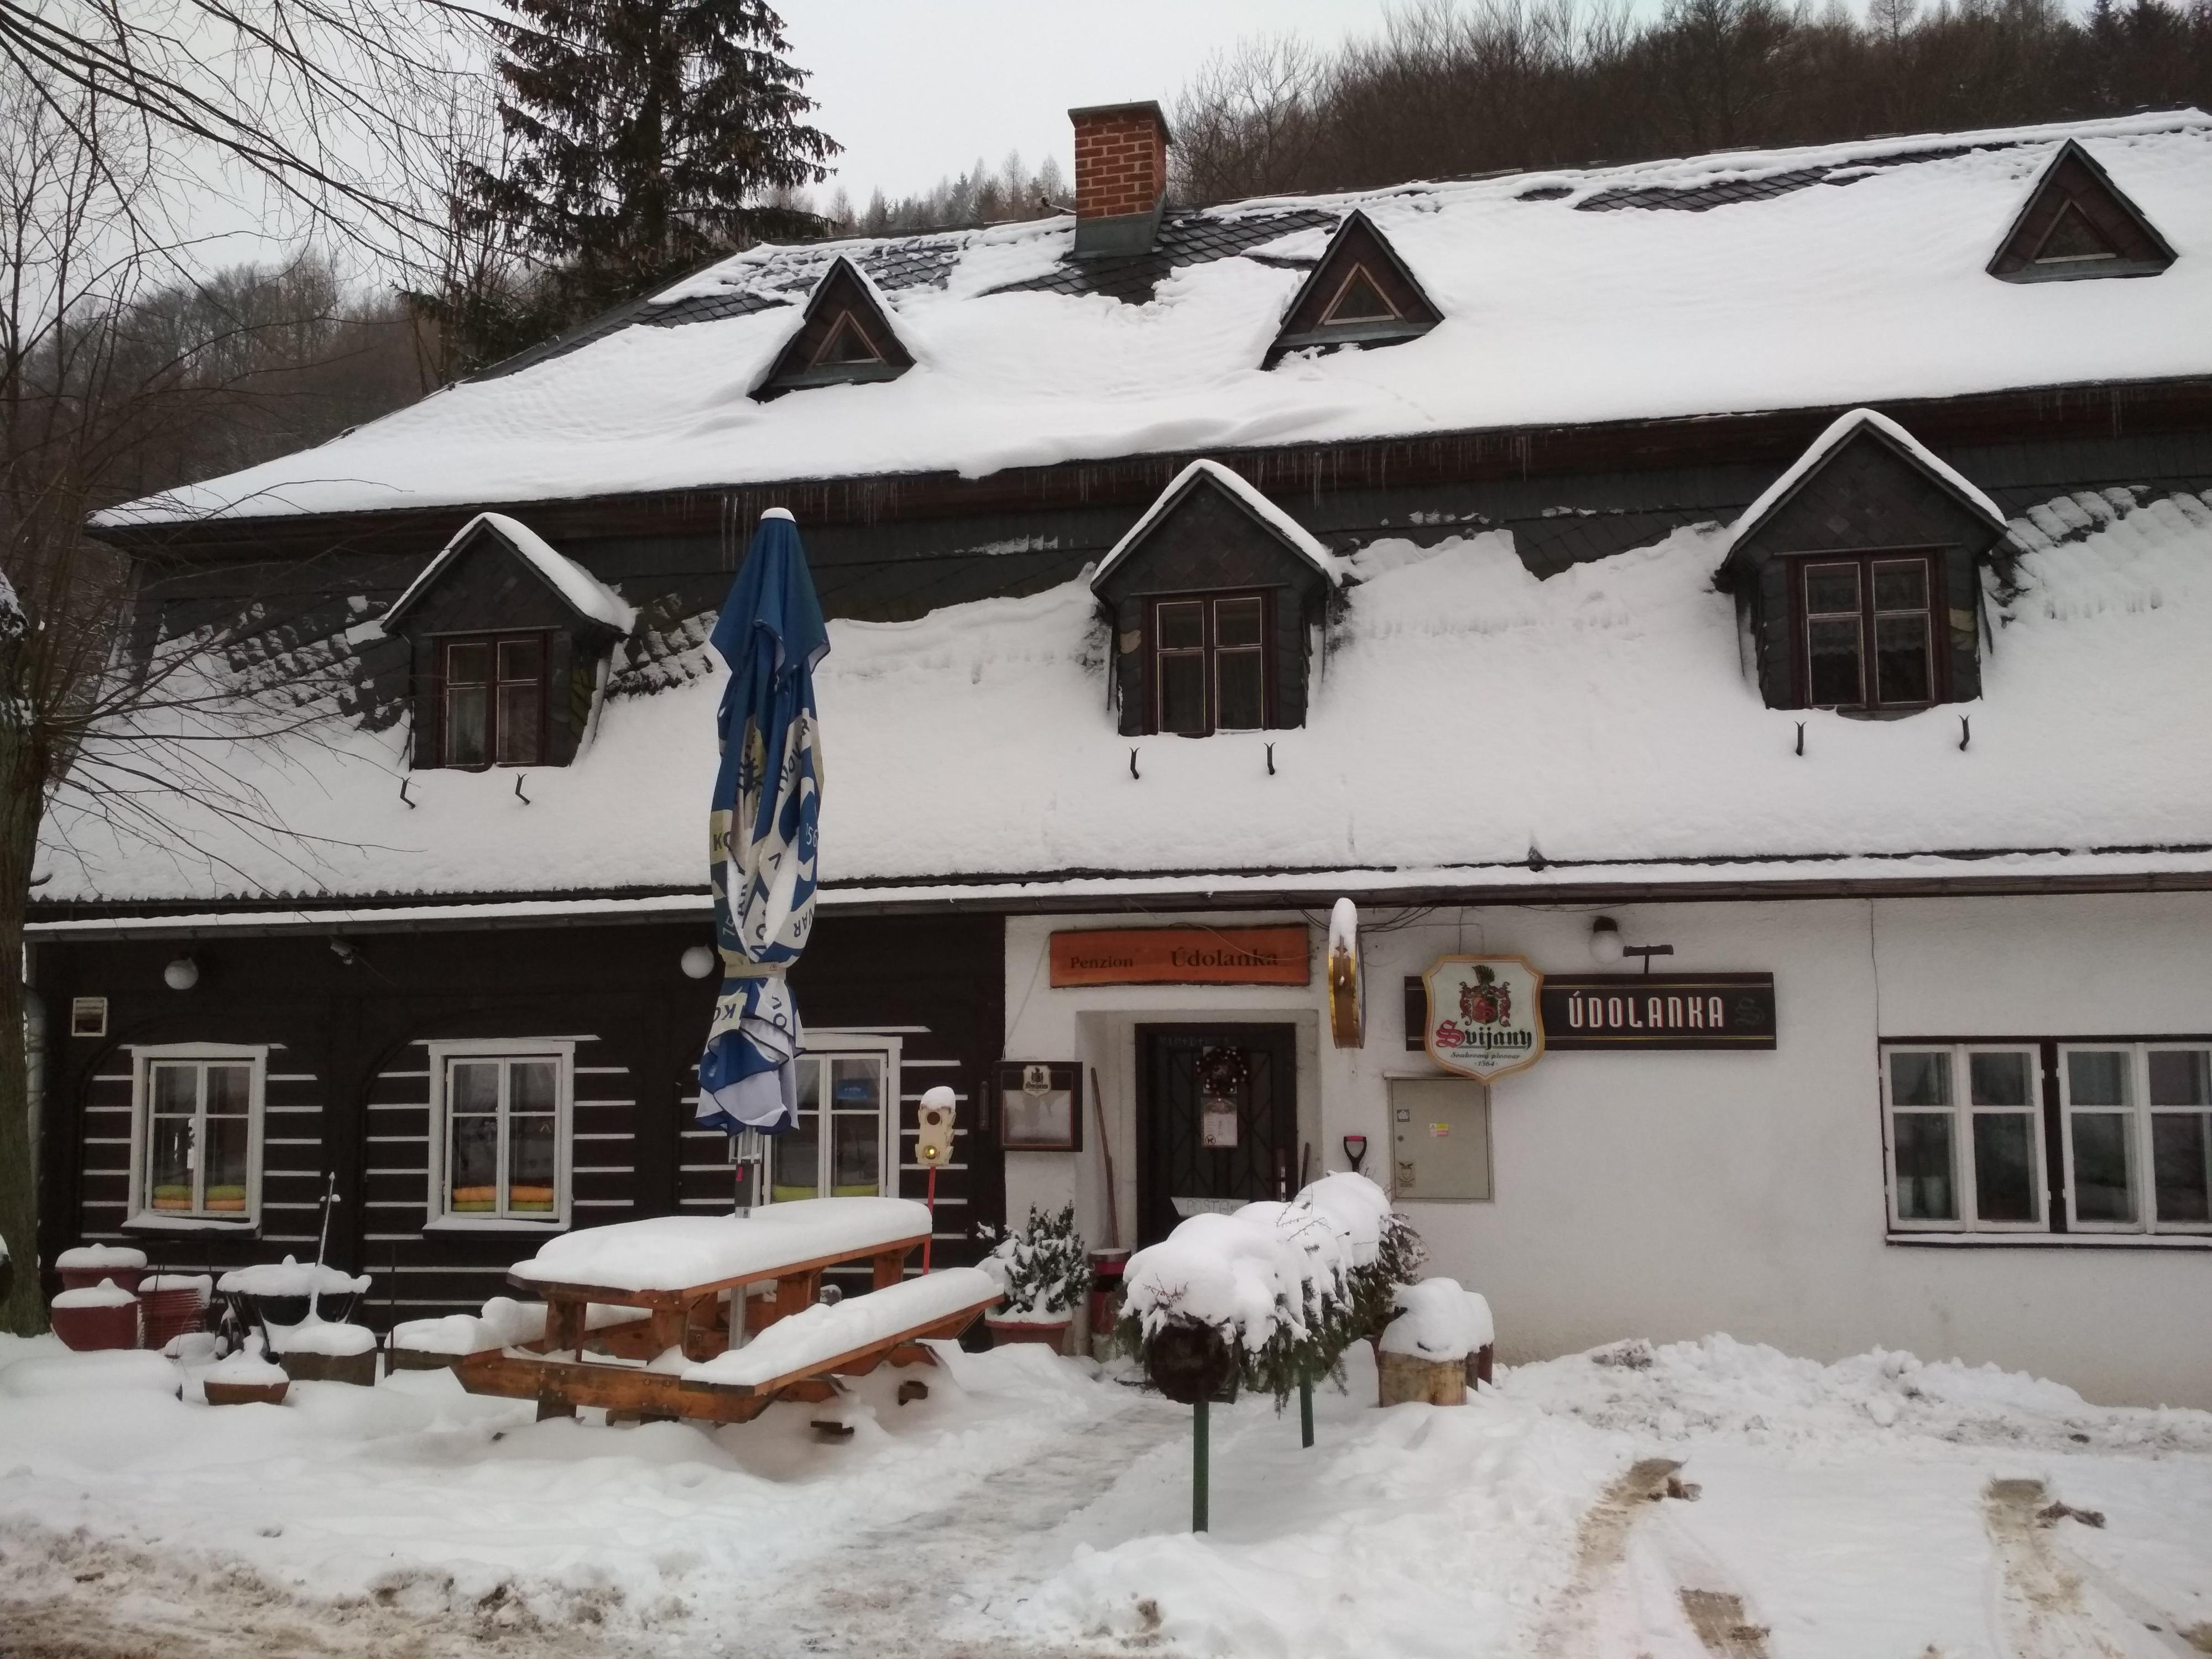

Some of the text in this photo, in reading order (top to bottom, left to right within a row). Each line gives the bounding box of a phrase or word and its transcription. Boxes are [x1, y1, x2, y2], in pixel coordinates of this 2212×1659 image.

[1070, 947, 1279, 969] Penzion Údolanka
[1568, 990, 1725, 1029] ÚDOLANKA
[1436, 1020, 1532, 1050] Svijany
